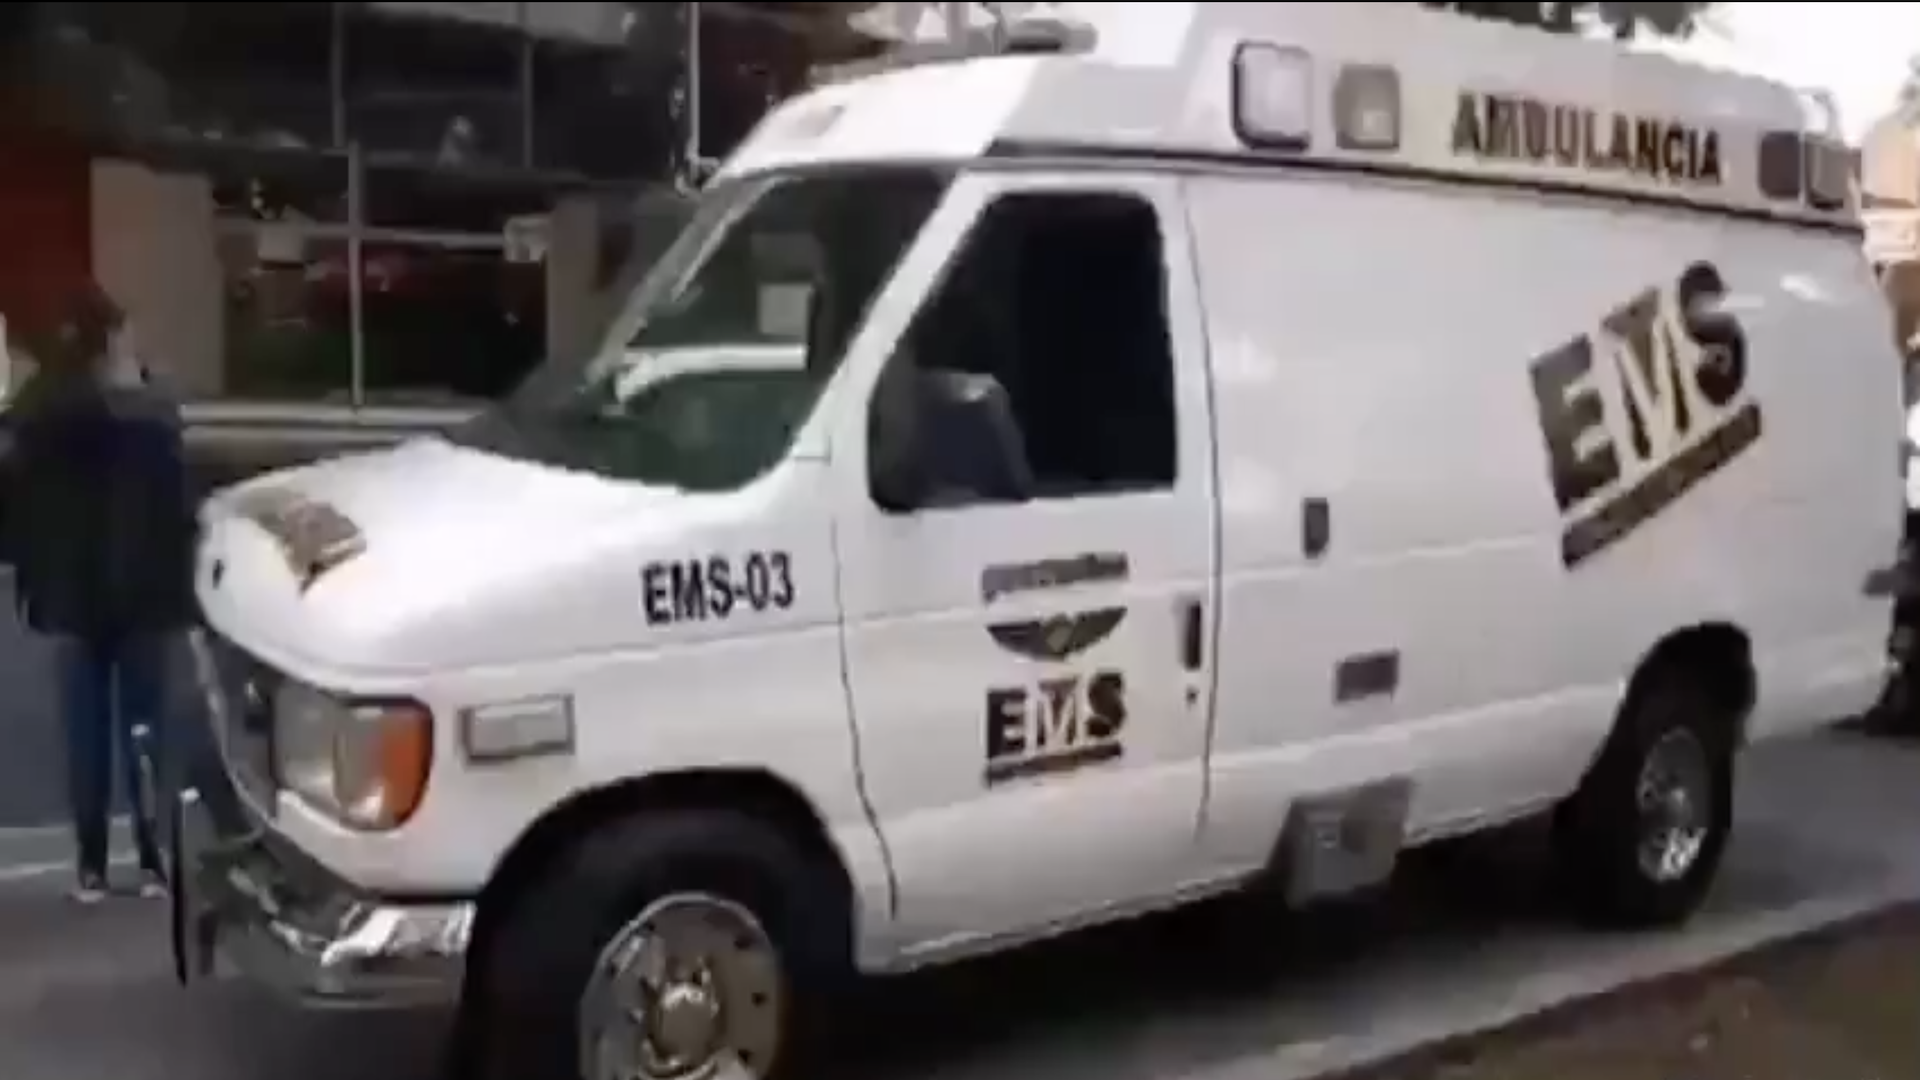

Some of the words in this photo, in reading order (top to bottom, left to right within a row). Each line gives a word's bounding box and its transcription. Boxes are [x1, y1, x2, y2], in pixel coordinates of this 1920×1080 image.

[1452, 92, 1723, 184] AMBULANCIA
[1529, 260, 1747, 514] EMS
[642, 551, 795, 626] EMS-03
[986, 672, 1126, 759] EMS
